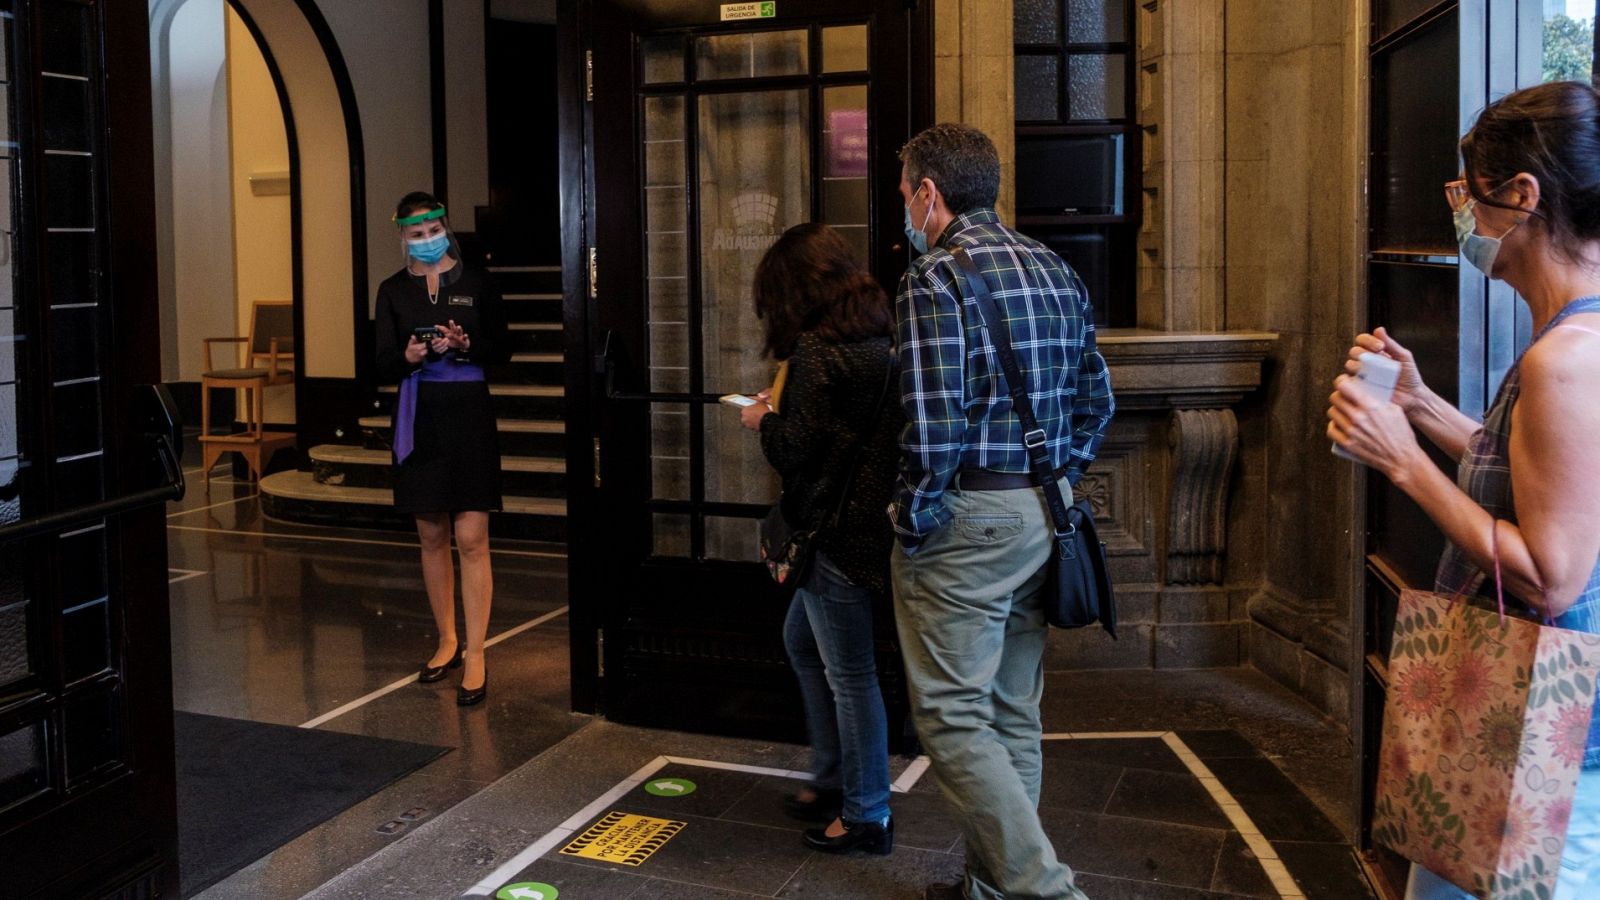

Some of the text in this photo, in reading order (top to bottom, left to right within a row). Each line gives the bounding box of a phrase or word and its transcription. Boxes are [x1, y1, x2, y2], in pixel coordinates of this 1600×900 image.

[595, 825, 628, 846] GRACIAS
[597, 819, 649, 857] POR MANTENER
[615, 823, 661, 857] LA DISTANCIA
